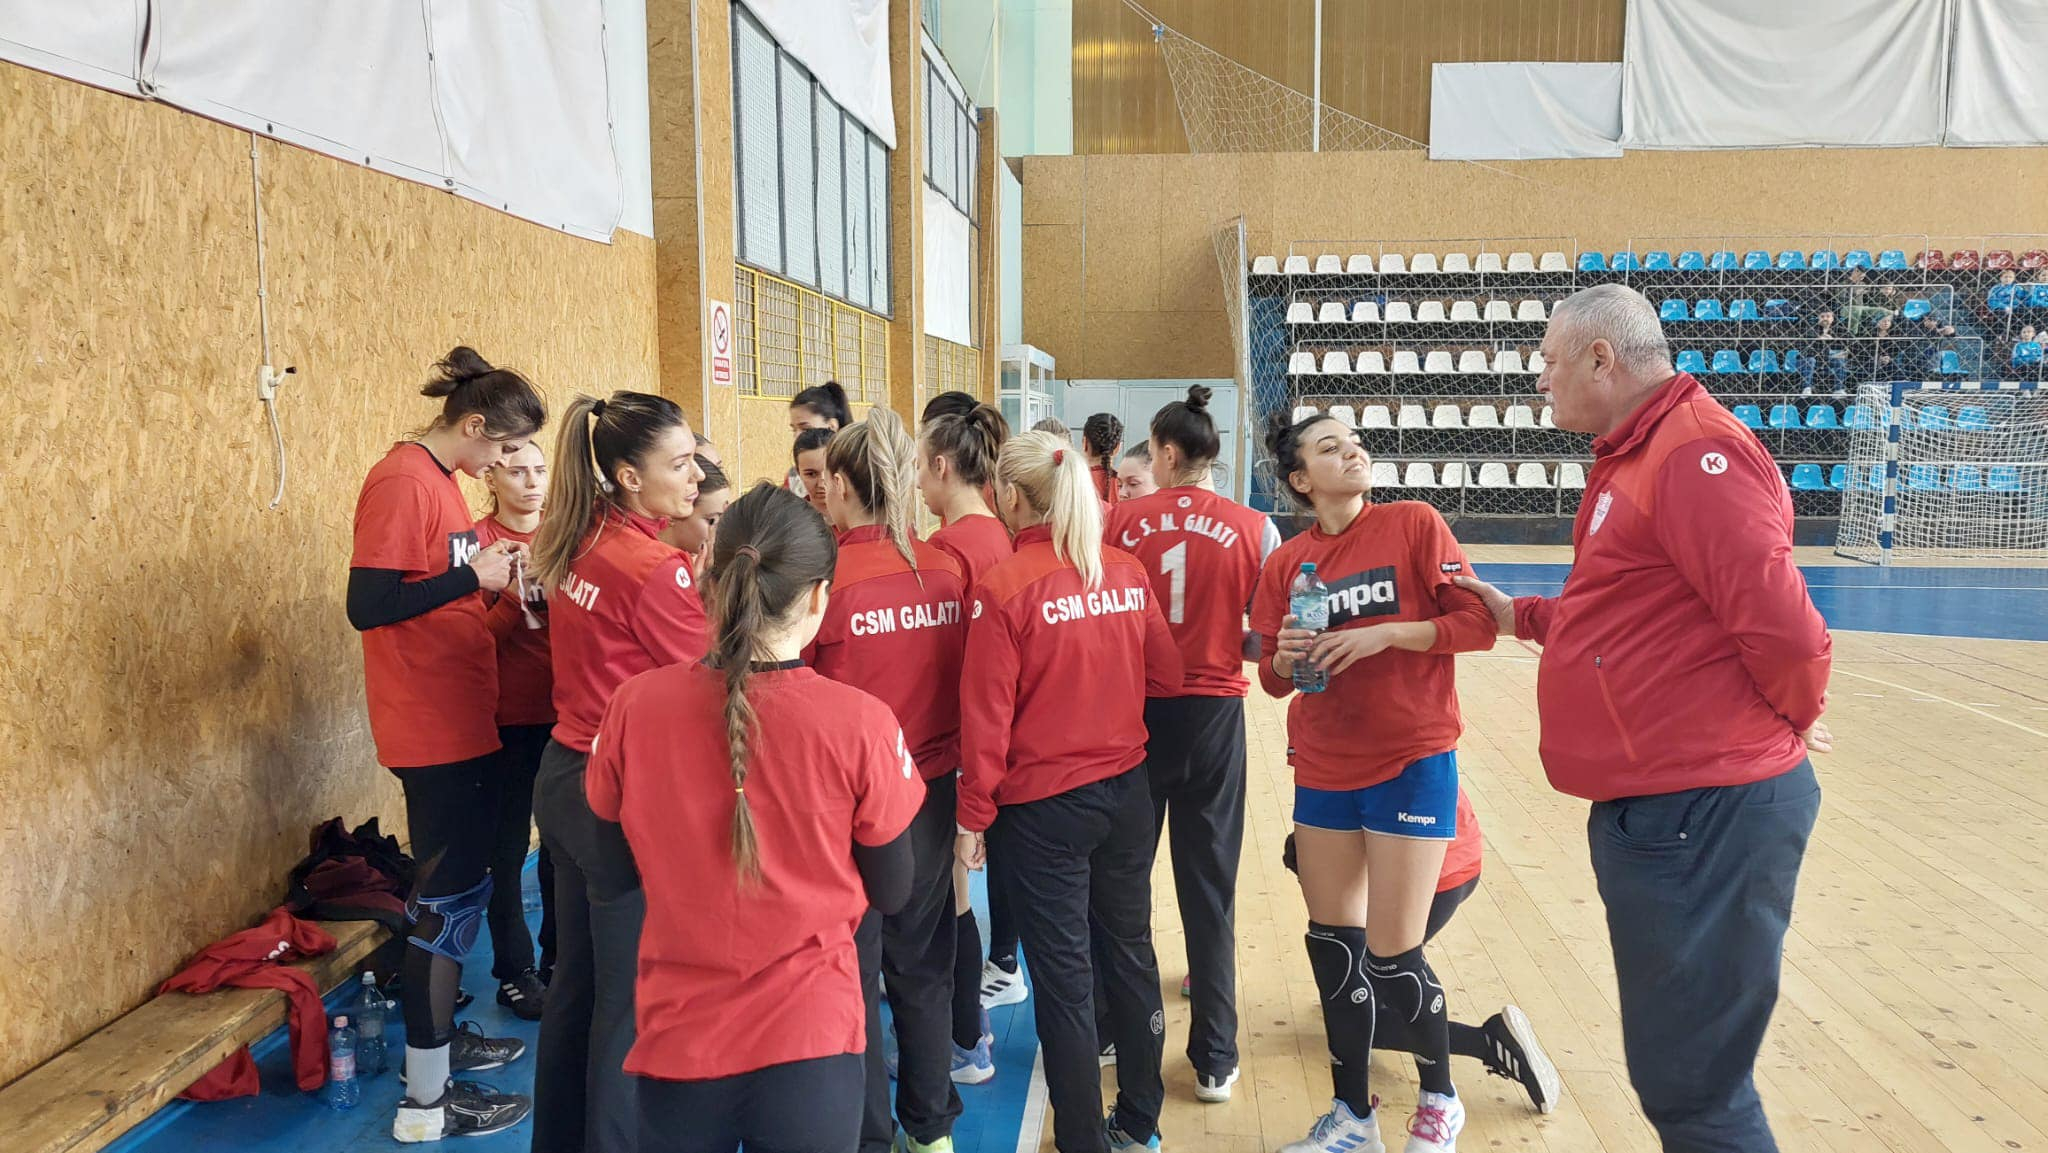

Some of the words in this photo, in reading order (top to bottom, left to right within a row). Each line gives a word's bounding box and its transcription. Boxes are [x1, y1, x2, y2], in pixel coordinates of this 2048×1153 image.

[1184, 513, 1239, 548] GALATI
[1161, 540, 1187, 623] 1
[850, 607, 896, 636] CSM
[900, 600, 960, 629] GALATI
[1042, 594, 1085, 624] CSM
[1087, 587, 1145, 616] GALATI
[1398, 812, 1436, 827] Kempa
